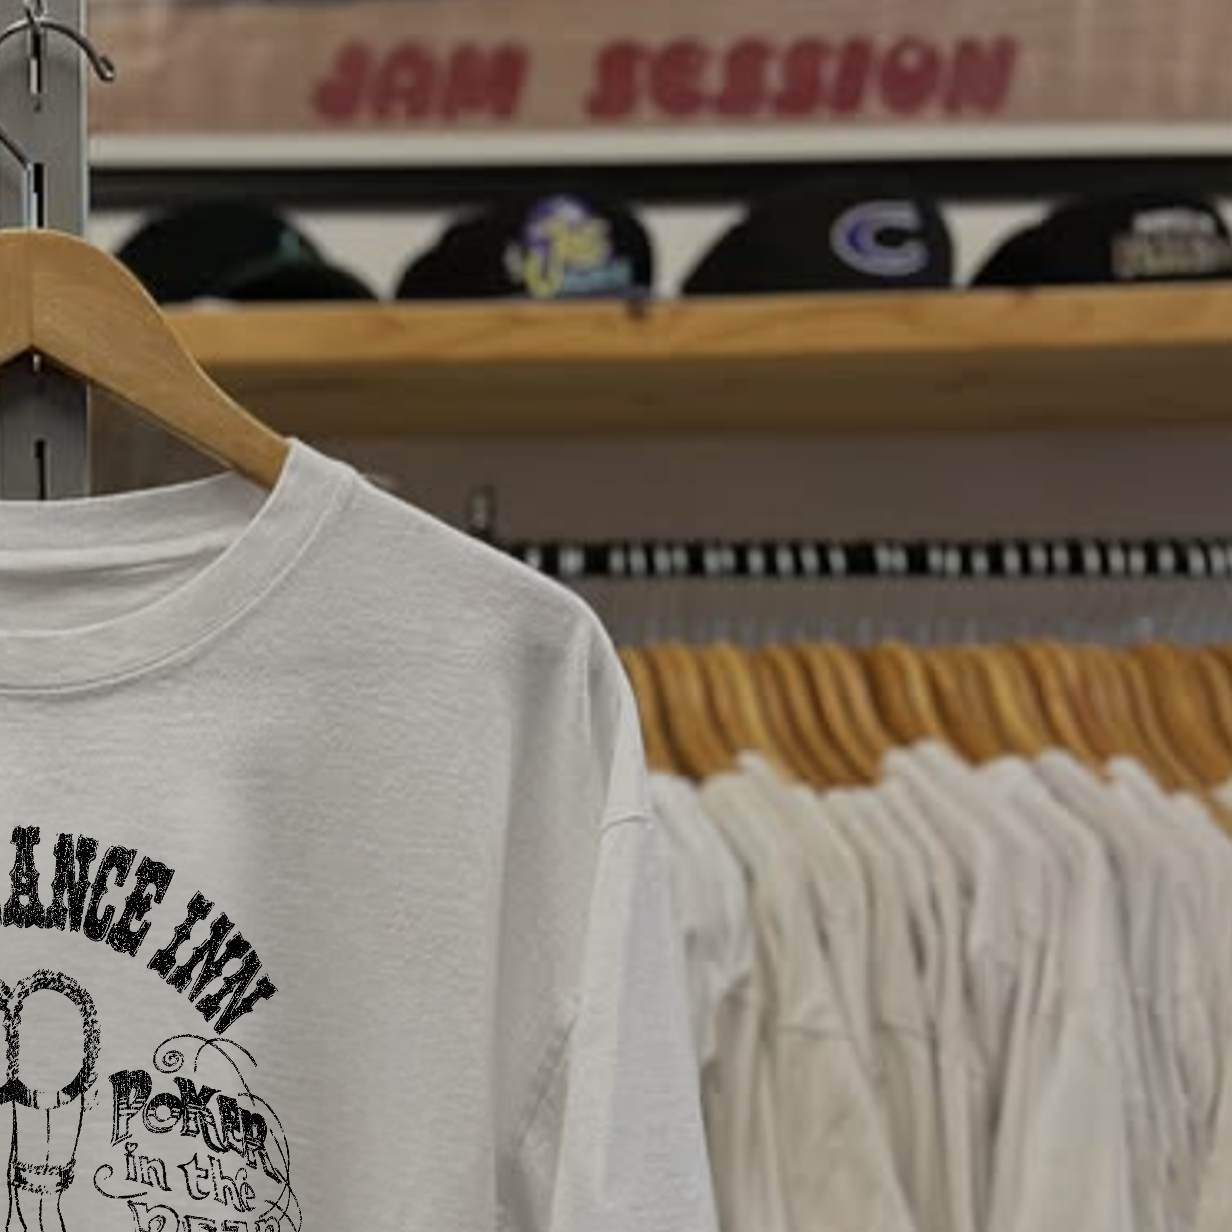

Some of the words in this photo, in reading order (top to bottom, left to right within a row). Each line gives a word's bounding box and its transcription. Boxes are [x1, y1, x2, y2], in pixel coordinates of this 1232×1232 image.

[311, 38, 531, 122] JAM
[584, 35, 1019, 118] SESSION
[148, 890, 279, 1035] INN
[108, 1069, 282, 1184] POKER
[124, 1141, 172, 1192] in
[177, 1152, 256, 1213] the
